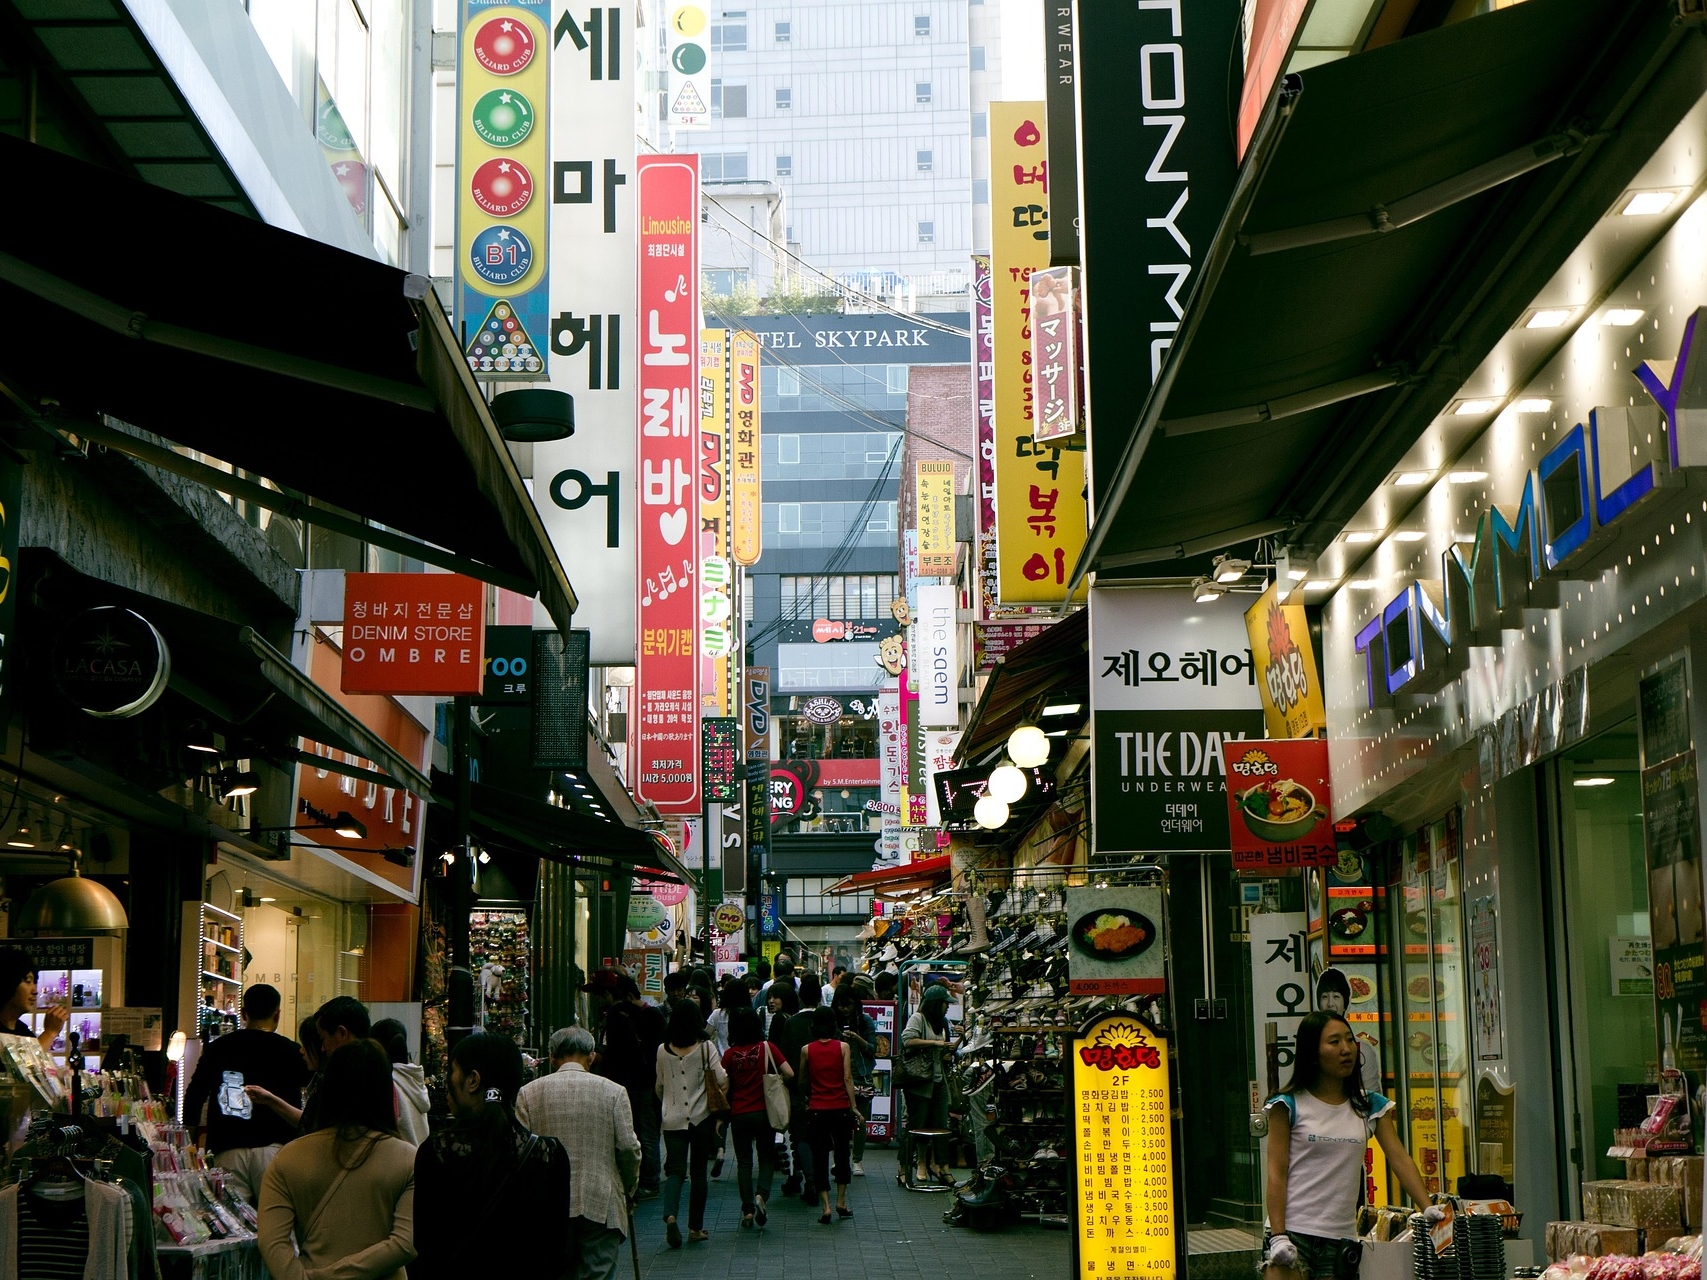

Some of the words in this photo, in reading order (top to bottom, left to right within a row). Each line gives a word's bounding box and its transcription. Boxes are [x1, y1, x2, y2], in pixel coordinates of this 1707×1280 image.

[475, 47, 510, 71] BILLIARD
[512, 48, 531, 69] CLUB
[681, 116, 697, 124] 5F
[474, 119, 509, 143] BILLIARD
[512, 120, 530, 140] CLUB
[473, 188, 508, 213] BILLIARD
[511, 189, 529, 209] CLUB
[642, 216, 691, 236] Limousine
[486, 245, 517, 265] B1
[472, 255, 507, 280] BILLIARD
[510, 257, 529, 277] CLUB
[550, 8, 626, 549] 세마헤어
[815, 329, 930, 348] SKYPARK
[1041, 318, 1065, 423] マッサージ
[739, 363, 754, 403] DVD
[643, 309, 692, 506] 노래방
[1058, 421, 1071, 432] 3F
[738, 410, 755, 469] 영화관
[701, 431, 722, 502] DVD
[921, 463, 951, 473] BULUJO
[1016, 434, 1065, 584] 떡볶이
[1354, 304, 1704, 710] TONYMOLY
[923, 556, 952, 567] 부르조
[352, 601, 408, 619] 청바지
[416, 602, 473, 620] 전문샵
[933, 607, 950, 641] the
[352, 626, 407, 640] DENIM
[414, 626, 472, 642] STORE
[643, 628, 693, 656] 분위기캡
[350, 647, 471, 663] OMBRE
[65, 659, 142, 675] LACASA
[1101, 648, 1256, 687] 제오헤어
[933, 646, 949, 705] saem
[503, 683, 527, 694] 크루
[746, 679, 768, 737] DVD
[809, 698, 839, 709] ASHLEY
[1115, 732, 1173, 777] THE
[1180, 732, 1245, 776] DA
[651, 760, 683, 769] 최저가격
[661, 773, 693, 783] 5,000원
[823, 778, 832, 786] by
[1165, 804, 1198, 818] 더데이
[1160, 819, 1203, 833] 언더웨어
[1266, 845, 1337, 865] 냄비국수
[719, 912, 741, 923] DVD
[1075, 982, 1100, 991] 4,000
[1112, 1076, 1130, 1086] 2F
[1081, 1090, 1129, 1101] 명화당김밥
[1082, 1102, 1129, 1113] 참치김밥
[1082, 1115, 1130, 1124] 떡볶이
[1083, 1140, 1131, 1150] 손만두
[1316, 1135, 1365, 1145] TONYMOLY
[1084, 1153, 1131, 1163] 비빔냉면
[1084, 1178, 1132, 1188] 비빔밥
[1085, 1190, 1133, 1201] 냄비국수
[1085, 1203, 1133, 1213] 생우동
[1086, 1216, 1134, 1226] 김치우동
[1086, 1228, 1134, 1238] 돈까스
